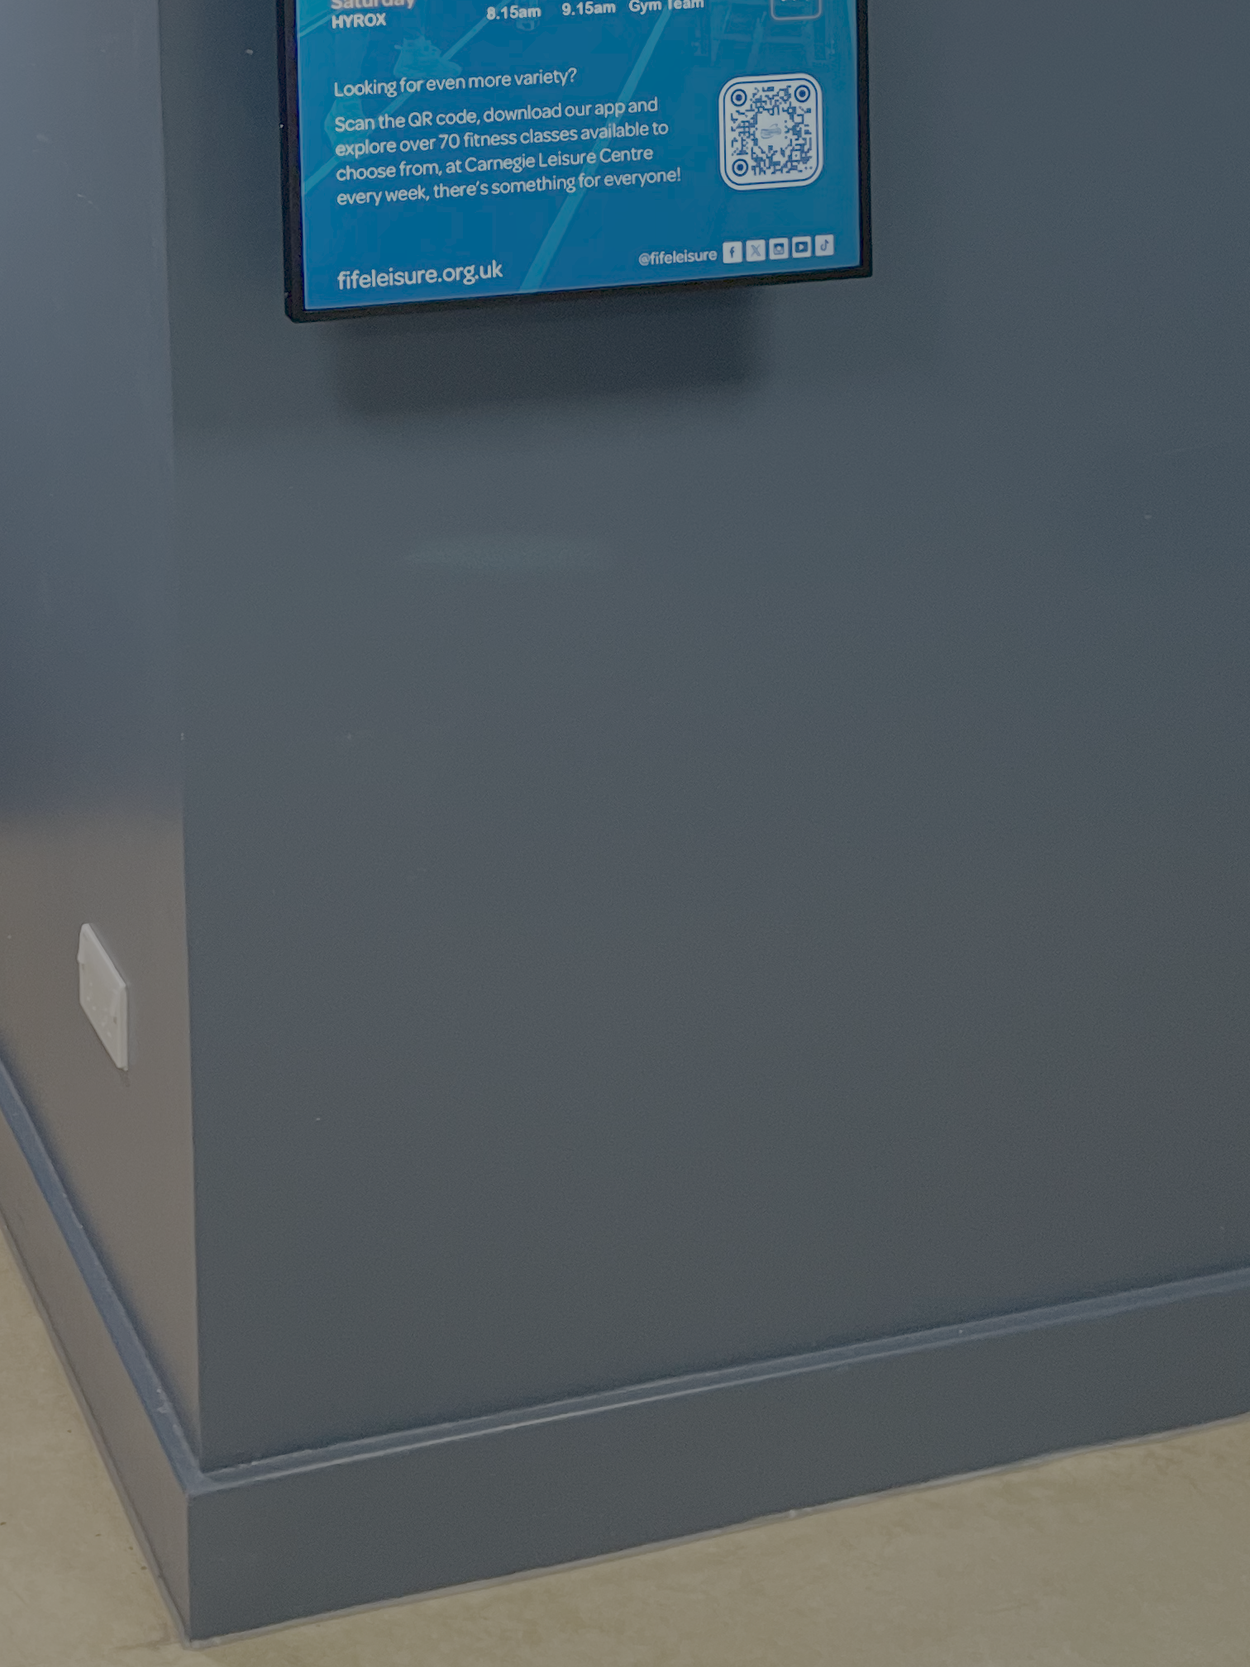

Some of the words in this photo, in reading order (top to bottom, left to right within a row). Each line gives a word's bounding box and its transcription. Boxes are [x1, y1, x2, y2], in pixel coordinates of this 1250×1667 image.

[331, 12, 387, 30] HYROX
[486, 4, 542, 21] 8.15am
[561, 0, 617, 16] 9.15am
[334, 78, 398, 98] Looking
[399, 76, 425, 93] for
[425, 77, 466, 92] even
[468, 74, 512, 89] more
[513, 67, 578, 87] variety?
[334, 116, 376, 133] Scan
[377, 113, 406, 130] the
[407, 110, 434, 128] QR
[435, 108, 481, 126] code,
[482, 102, 563, 123] download
[564, 103, 593, 118] our
[594, 101, 626, 119] app
[627, 96, 659, 114] and
[334, 138, 397, 160] explore
[399, 138, 437, 153] over
[438, 133, 461, 150] 70
[462, 131, 518, 148] fitness
[519, 128, 579, 145] classes
[580, 121, 650, 141] available
[651, 121, 669, 136] to
[335, 164, 397, 182] choose
[398, 160, 443, 177] from,
[445, 159, 463, 174] at
[464, 153, 536, 174] Carnegie
[538, 150, 597, 168] Leisure
[599, 147, 654, 164] Centre
[336, 190, 383, 207] every
[384, 184, 430, 202] week,
[491, 174, 577, 195] something
[577, 172, 602, 189] for
[603, 166, 681, 188] everyone!
[638, 248, 718, 267] @fifeleisure
[336, 259, 504, 291] fifeleisure.org.uk
